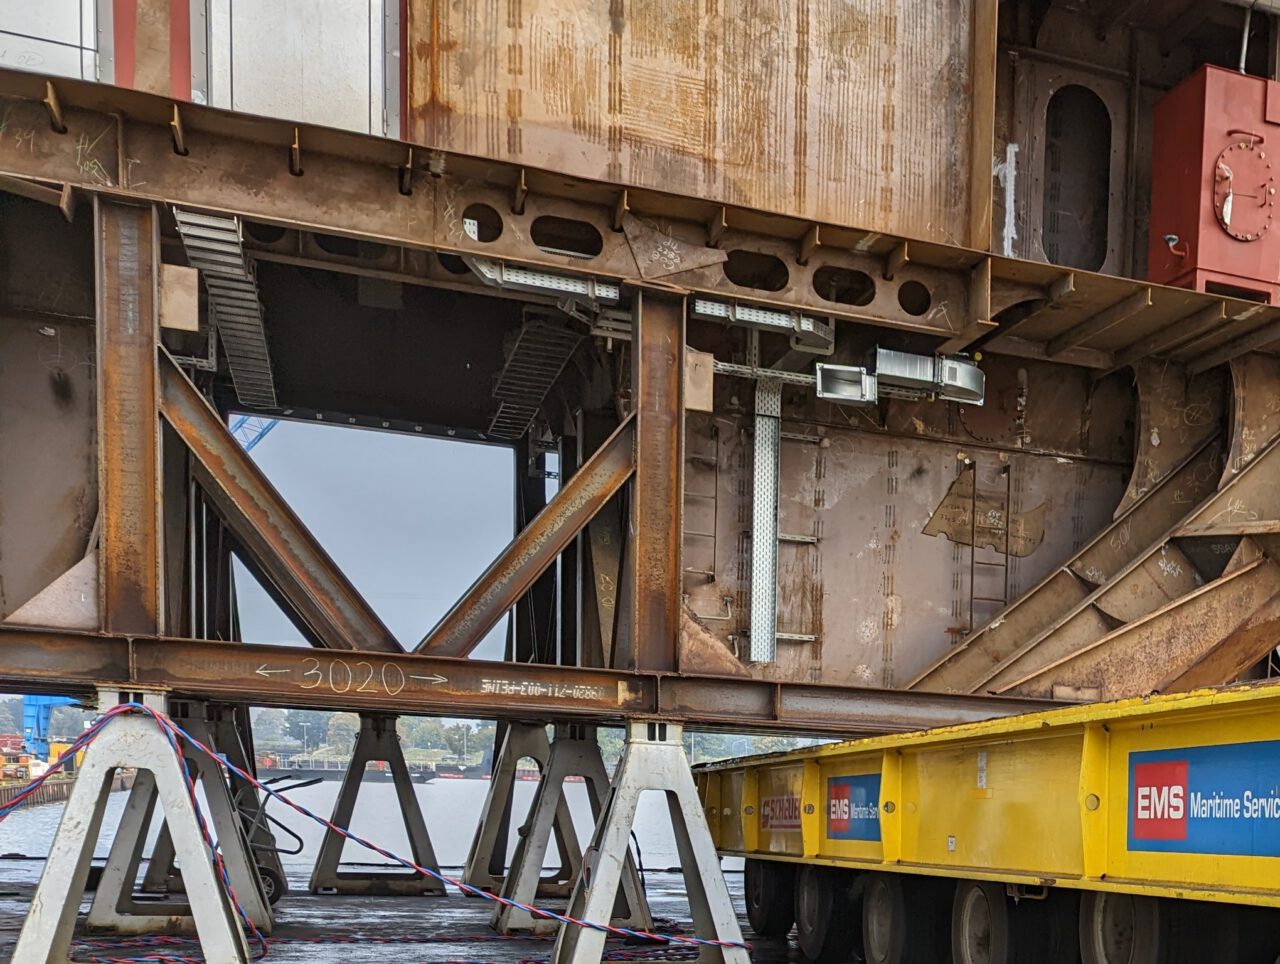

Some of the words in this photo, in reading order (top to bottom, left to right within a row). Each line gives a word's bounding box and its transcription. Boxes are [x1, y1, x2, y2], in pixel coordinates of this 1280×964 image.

[300, 656, 405, 696] 3020
[769, 797, 801, 821] SCHEUE
[830, 798, 849, 820] EMS
[1137, 785, 1184, 820] EMS
[1190, 791, 1241, 819] Maritime
